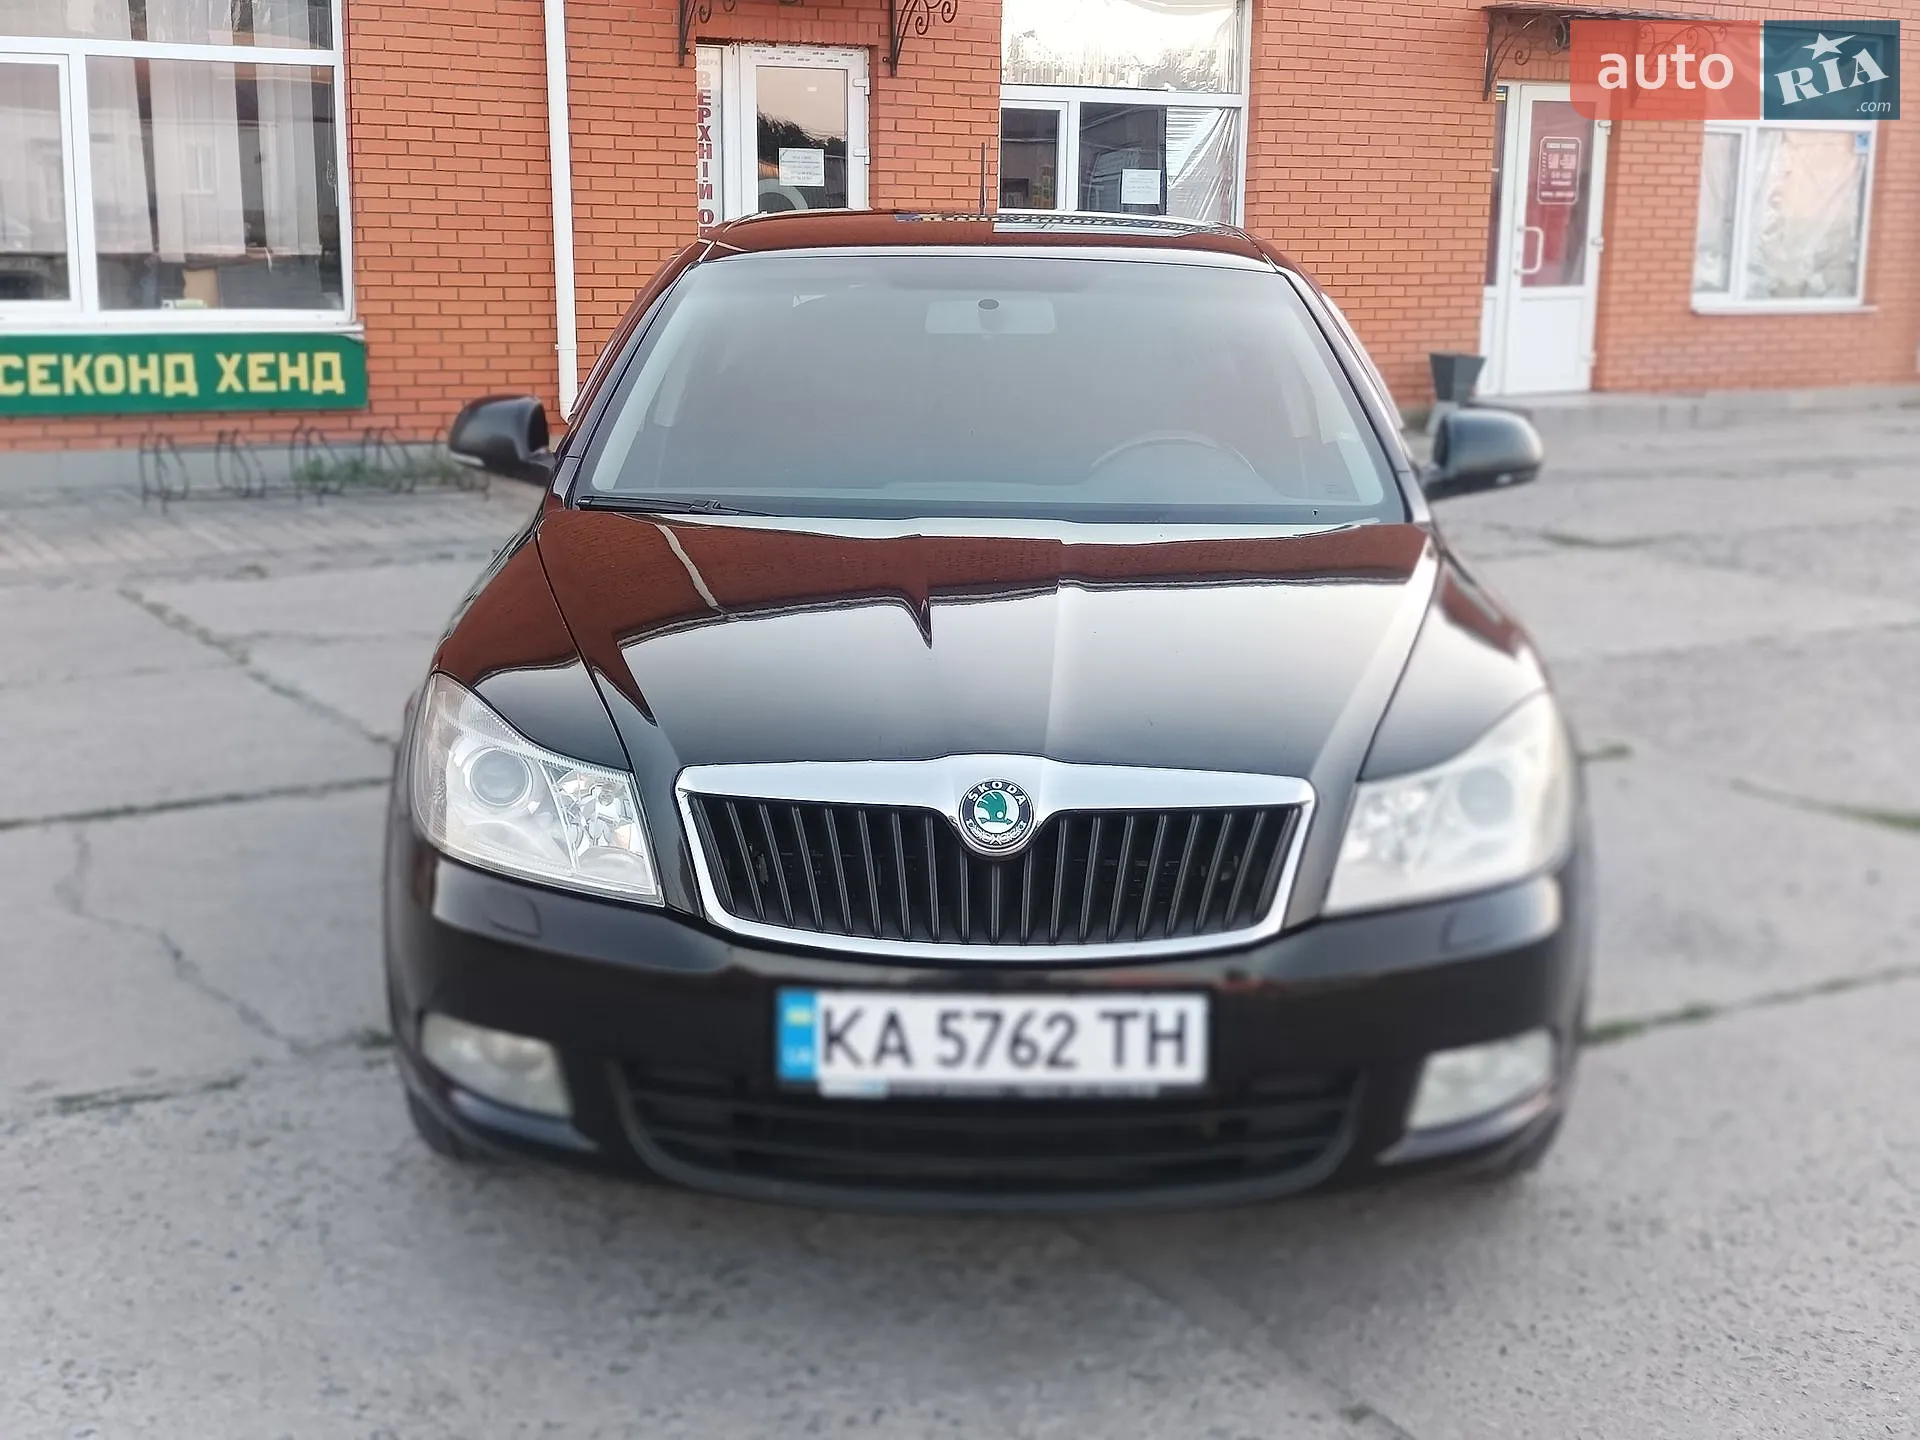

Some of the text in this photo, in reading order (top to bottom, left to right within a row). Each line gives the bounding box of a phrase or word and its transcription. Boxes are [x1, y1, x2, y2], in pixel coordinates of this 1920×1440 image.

[697, 71, 714, 200] ВЕРХНІЙ
[0, 352, 346, 397] СЕКОНД ХЕНД
[822, 1007, 1189, 1070] KA 5762 TH
